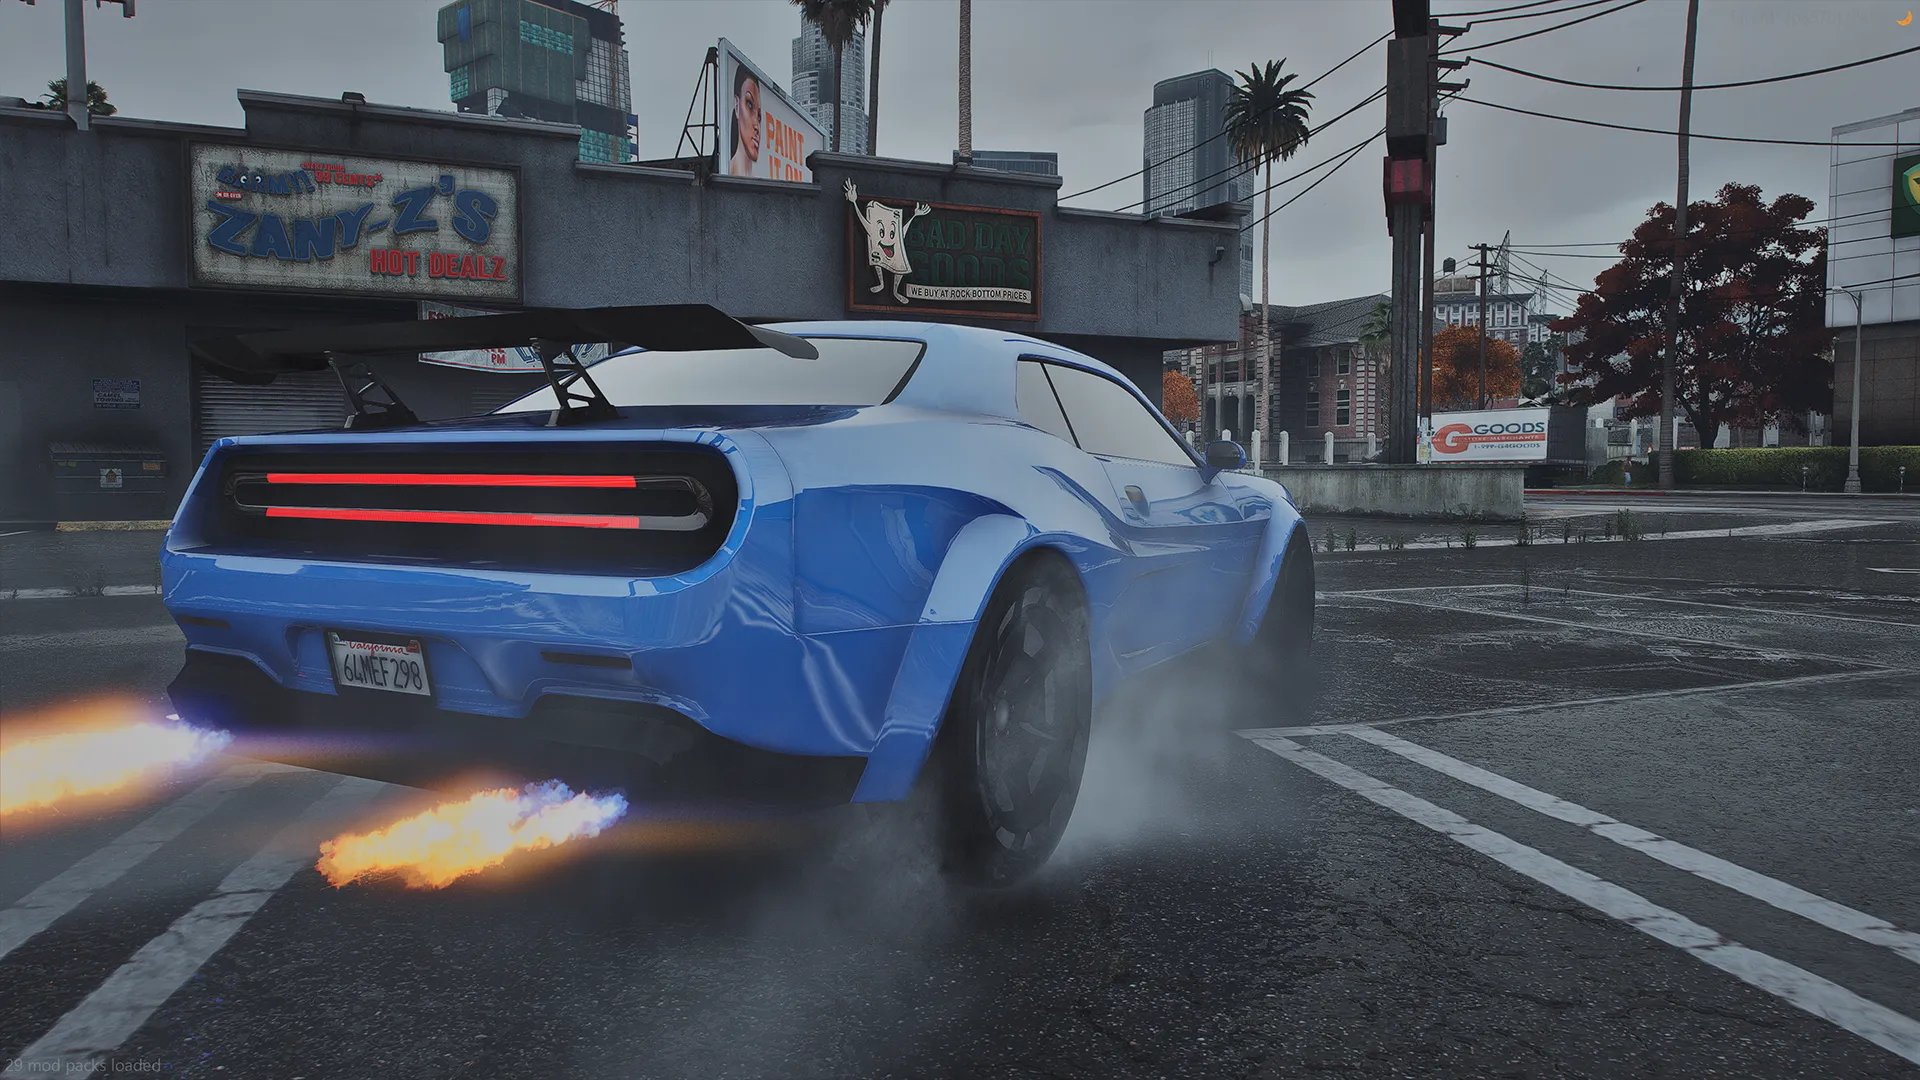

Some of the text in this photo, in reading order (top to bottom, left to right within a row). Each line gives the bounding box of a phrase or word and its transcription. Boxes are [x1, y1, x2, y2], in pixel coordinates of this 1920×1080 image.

[765, 111, 804, 167] PAINT
[315, 170, 332, 183] 99
[769, 154, 803, 182] IT ON
[207, 174, 498, 262] ZANY-Z'S
[906, 218, 1031, 254] BAD DAY
[371, 248, 507, 281] HOT DEALZ
[909, 249, 1031, 290] GOODS
[911, 288, 1028, 301] WE BUY AT ROCK BOTTOM PRICES
[491, 353, 505, 364] PM
[1473, 422, 1545, 435] GOODS
[344, 654, 423, 690] 64MEF298
